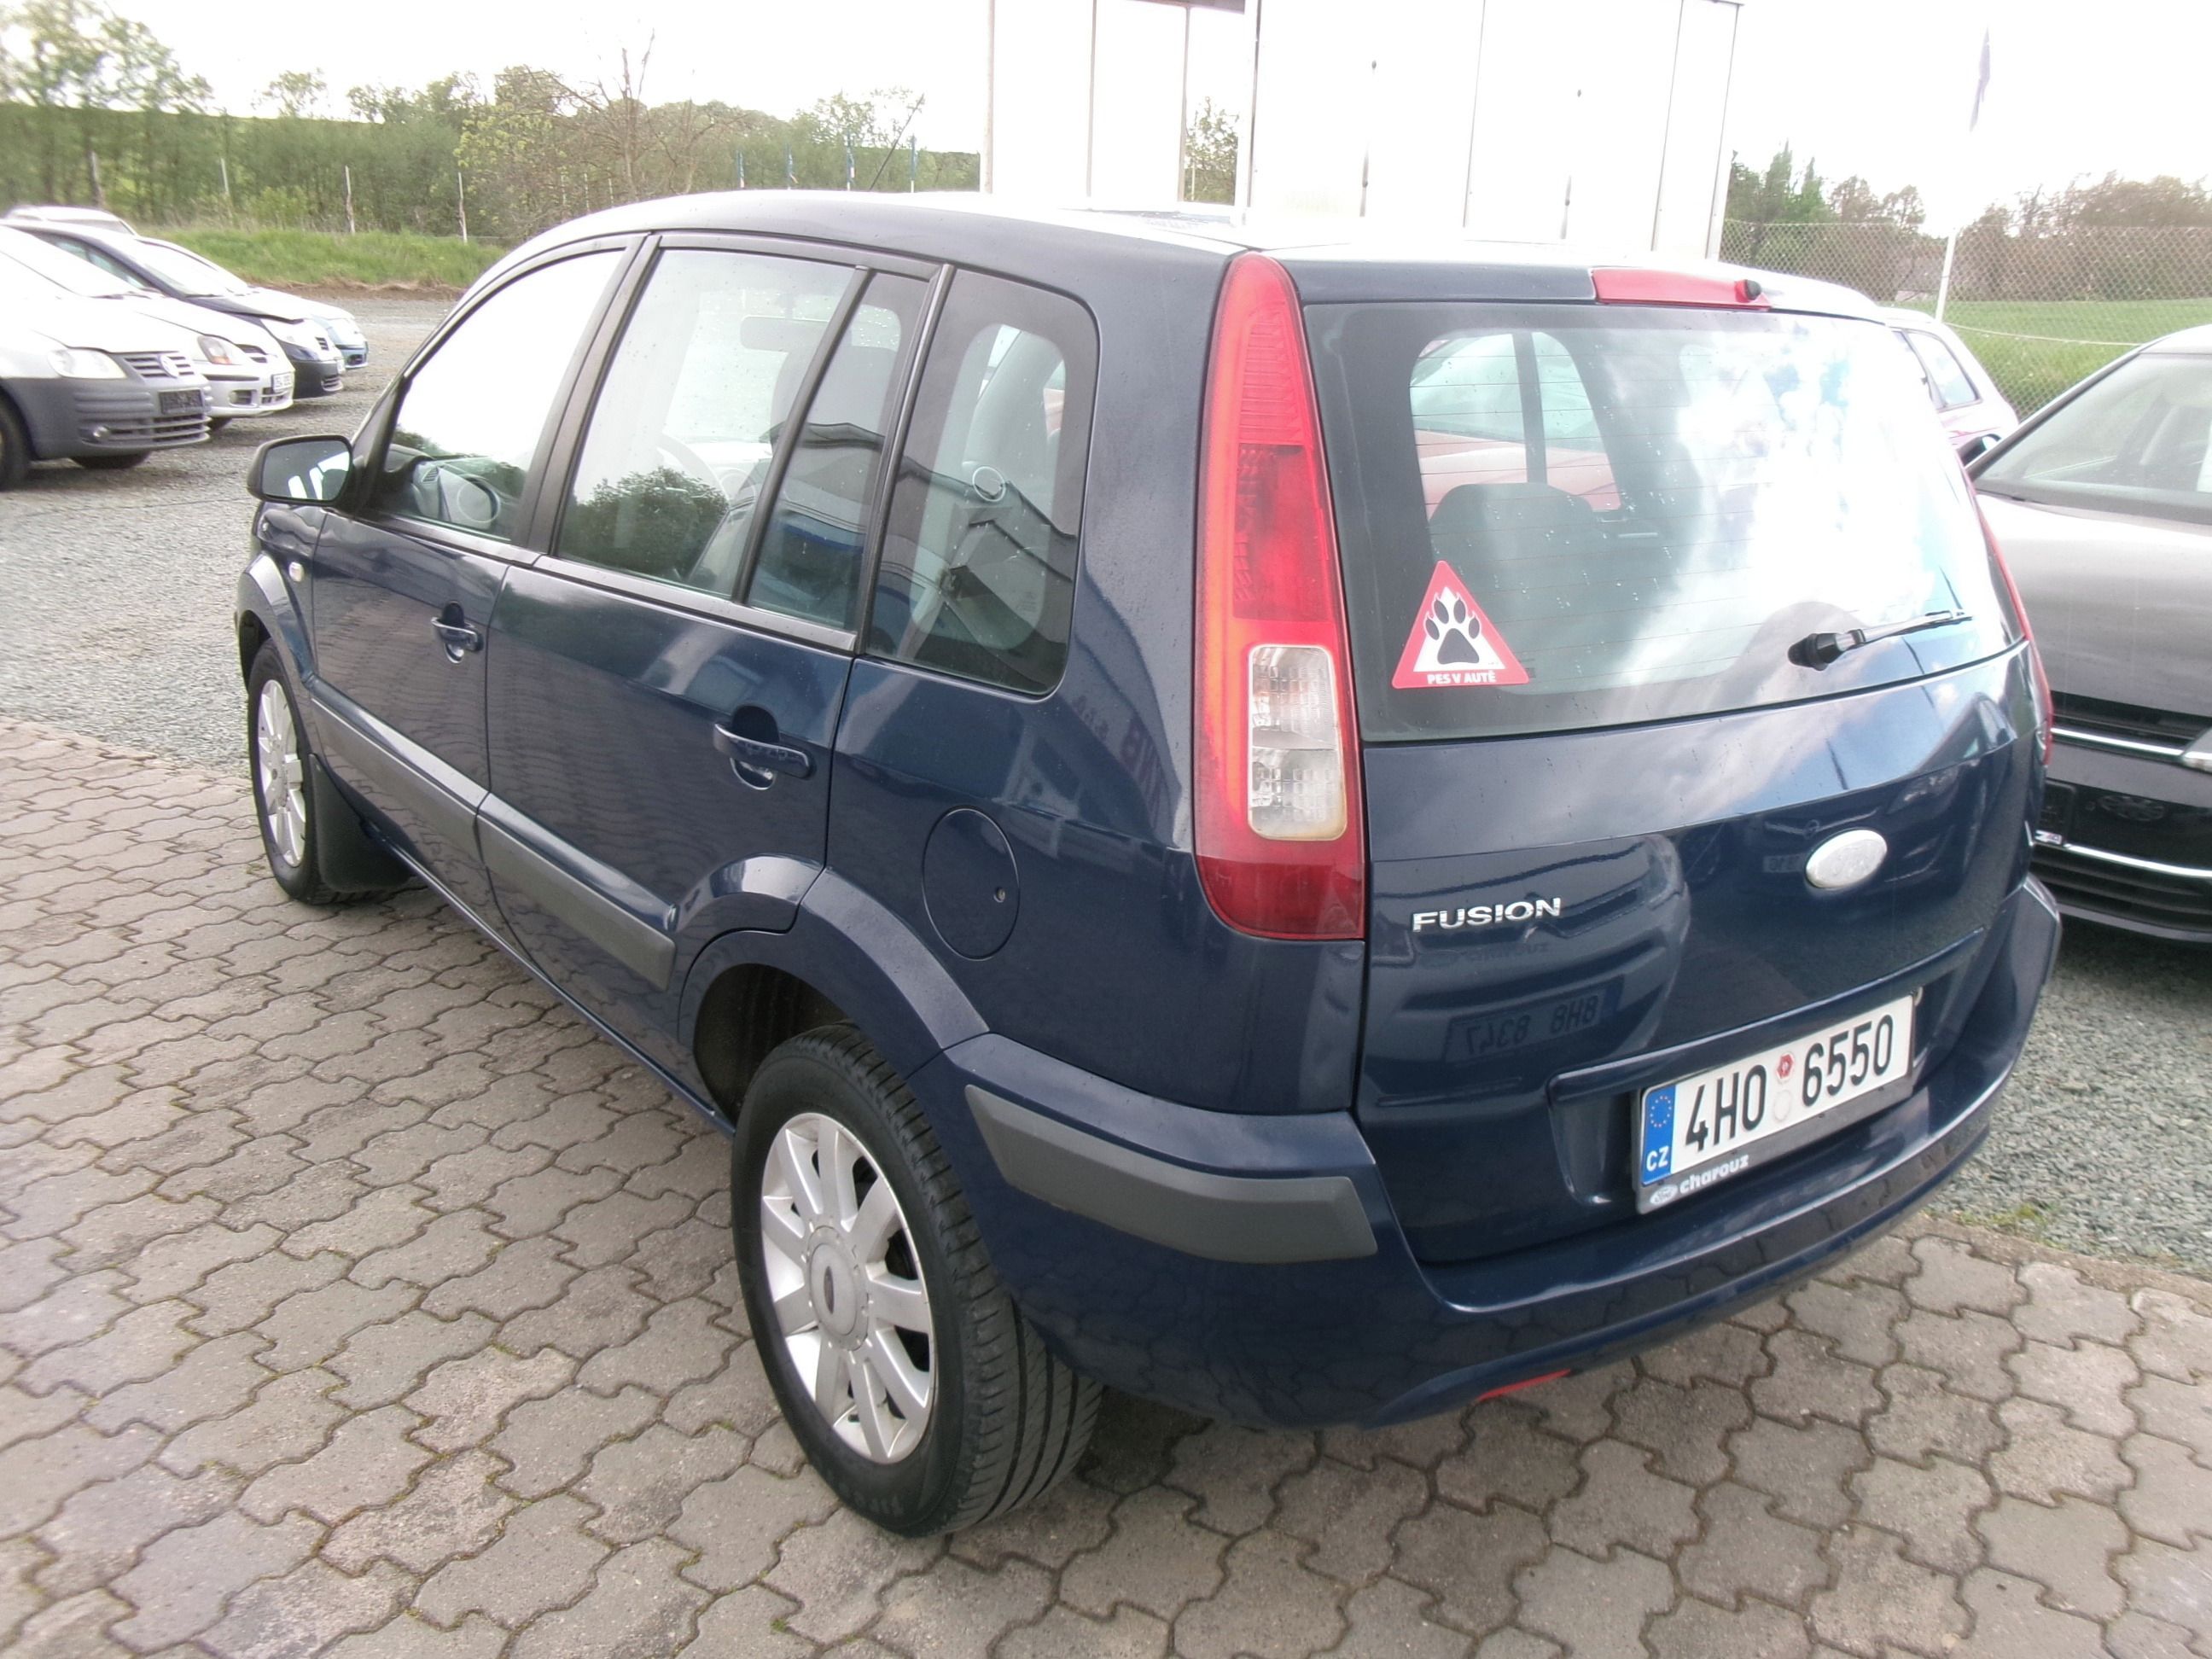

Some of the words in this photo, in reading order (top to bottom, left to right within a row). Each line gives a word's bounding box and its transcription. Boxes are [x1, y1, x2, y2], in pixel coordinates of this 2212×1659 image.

[1427, 673, 1451, 684] PES
[1452, 672, 1462, 684] V
[1412, 898, 1561, 932] FUSION
[1802, 1014, 1894, 1108] 6550
[1646, 1146, 1669, 1172] CZ
